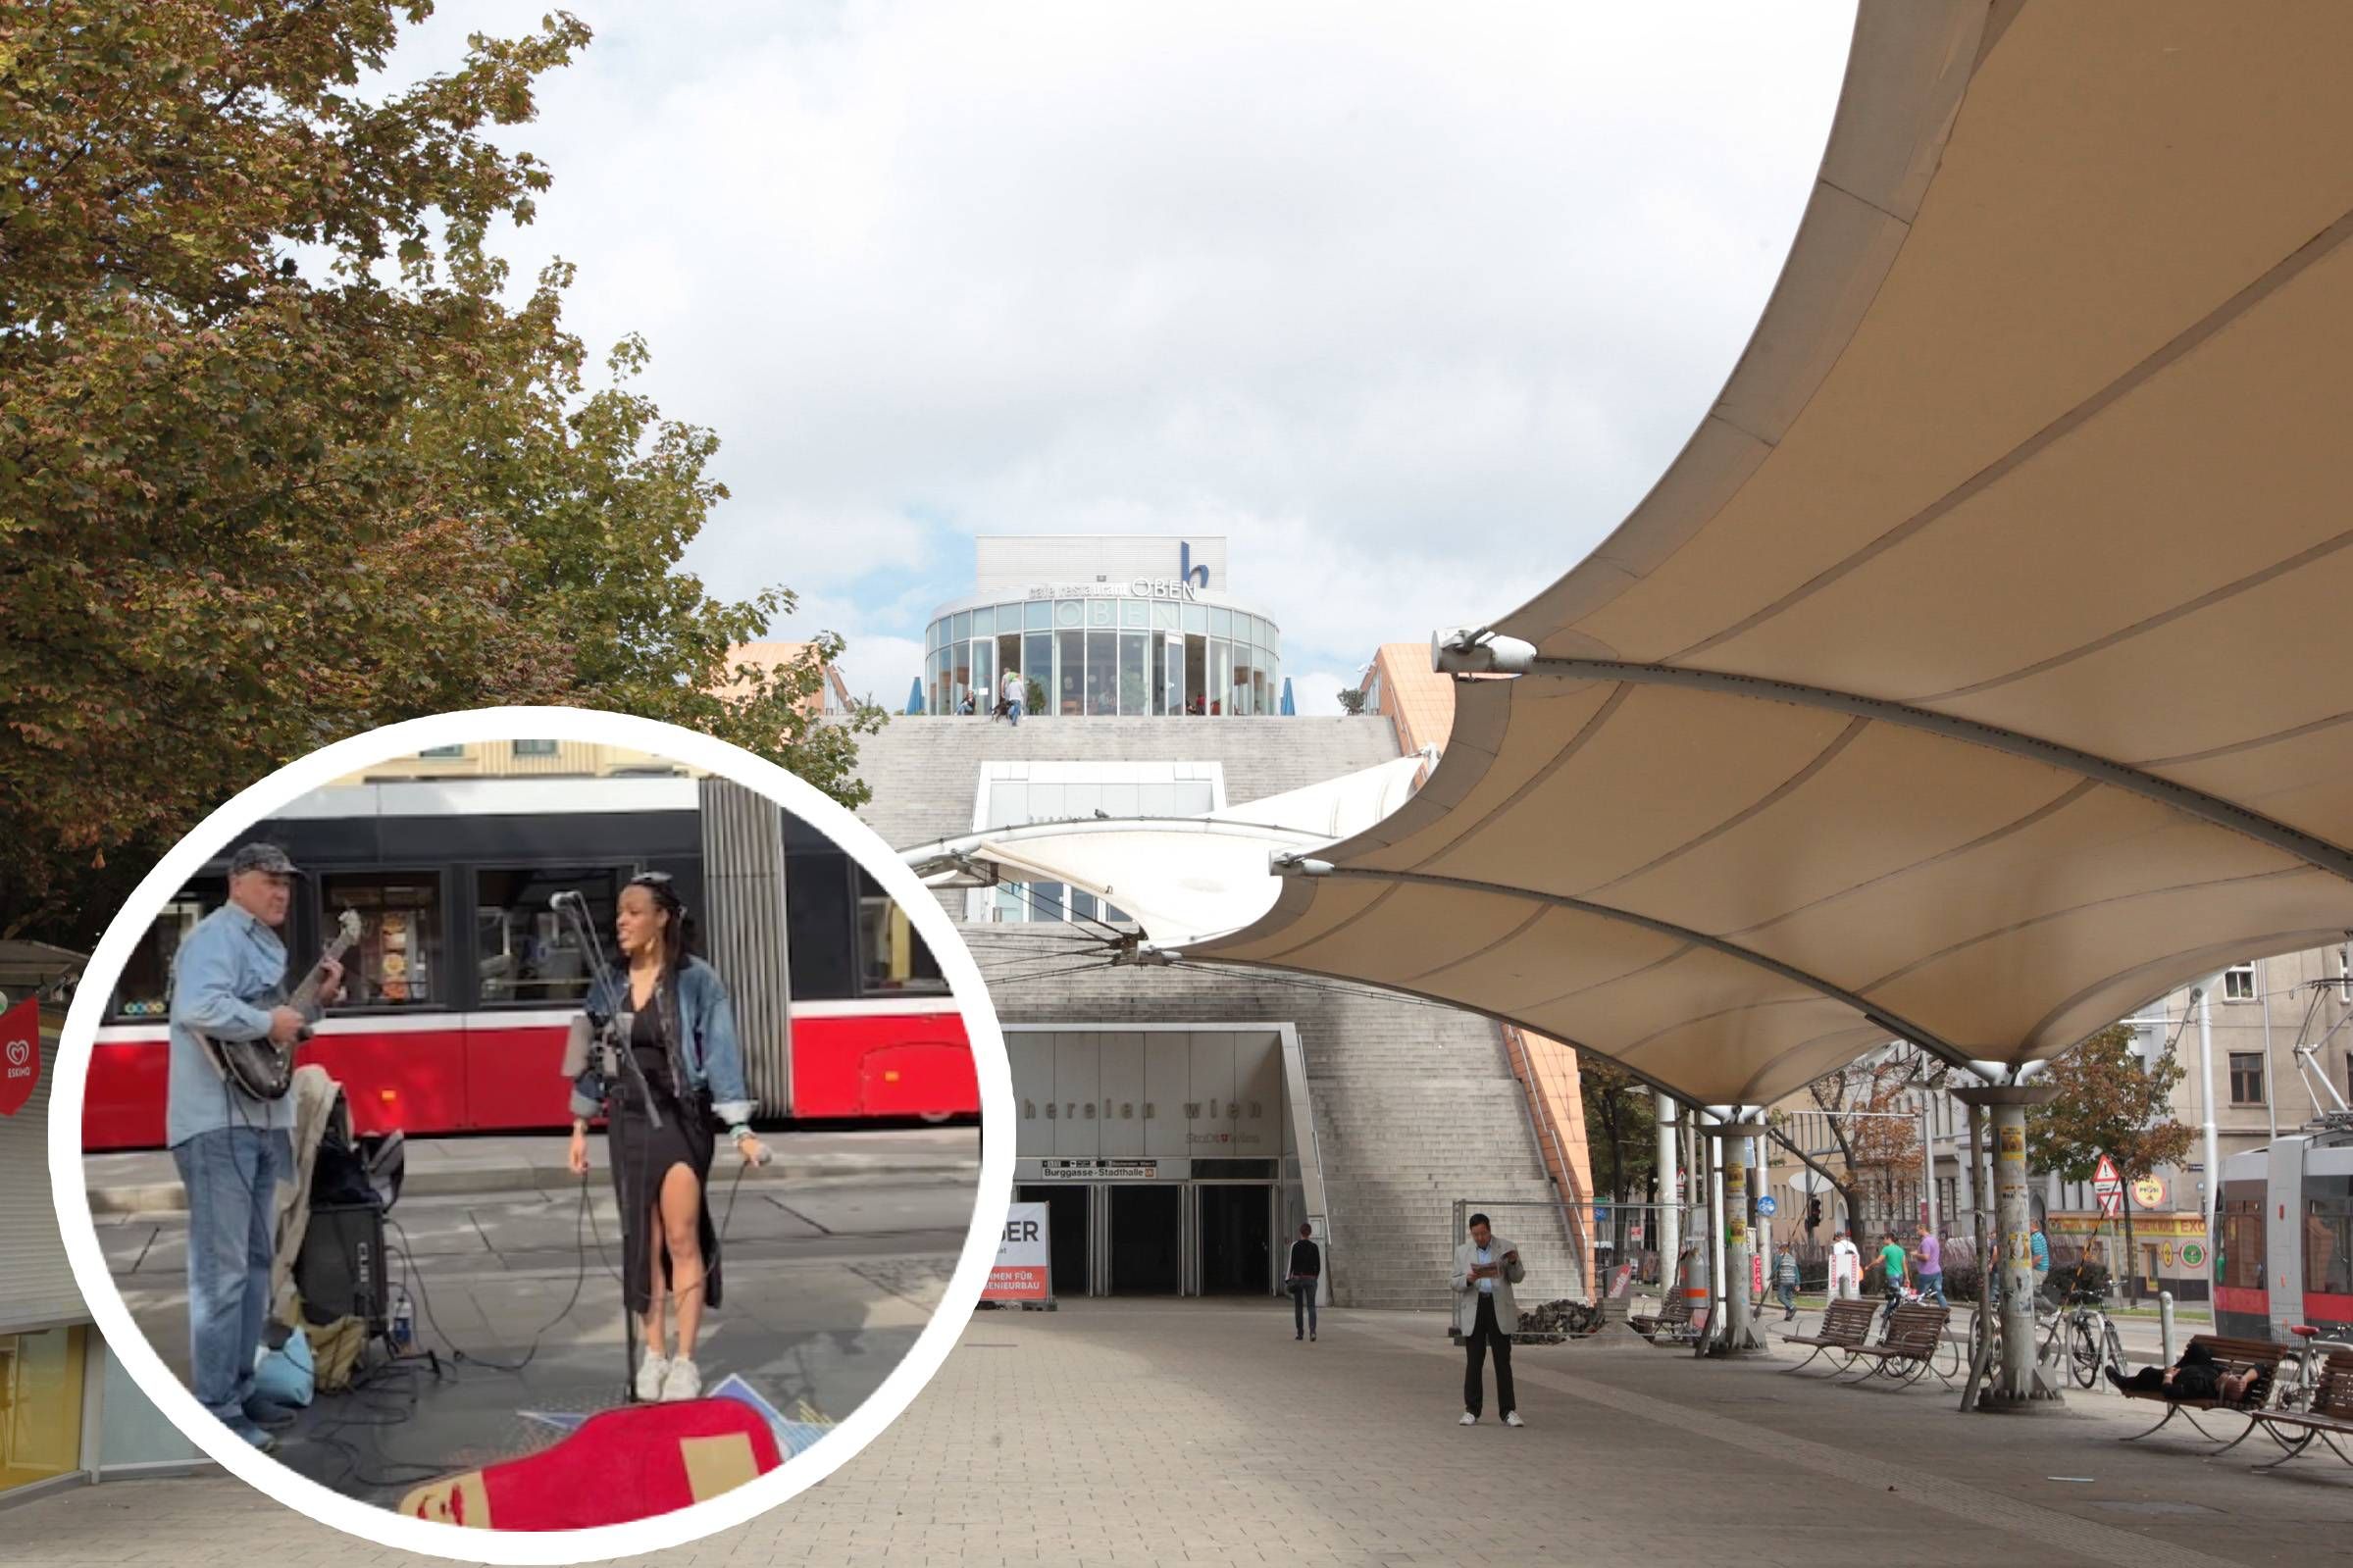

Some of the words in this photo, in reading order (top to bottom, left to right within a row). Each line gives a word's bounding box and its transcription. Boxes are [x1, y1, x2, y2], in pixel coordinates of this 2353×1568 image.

[1131, 578, 1197, 600] OBEN
[8, 1067, 30, 1078] ESKIMO
[1184, 1097, 1262, 1119] wien
[1001, 1221, 1039, 1241] ER
